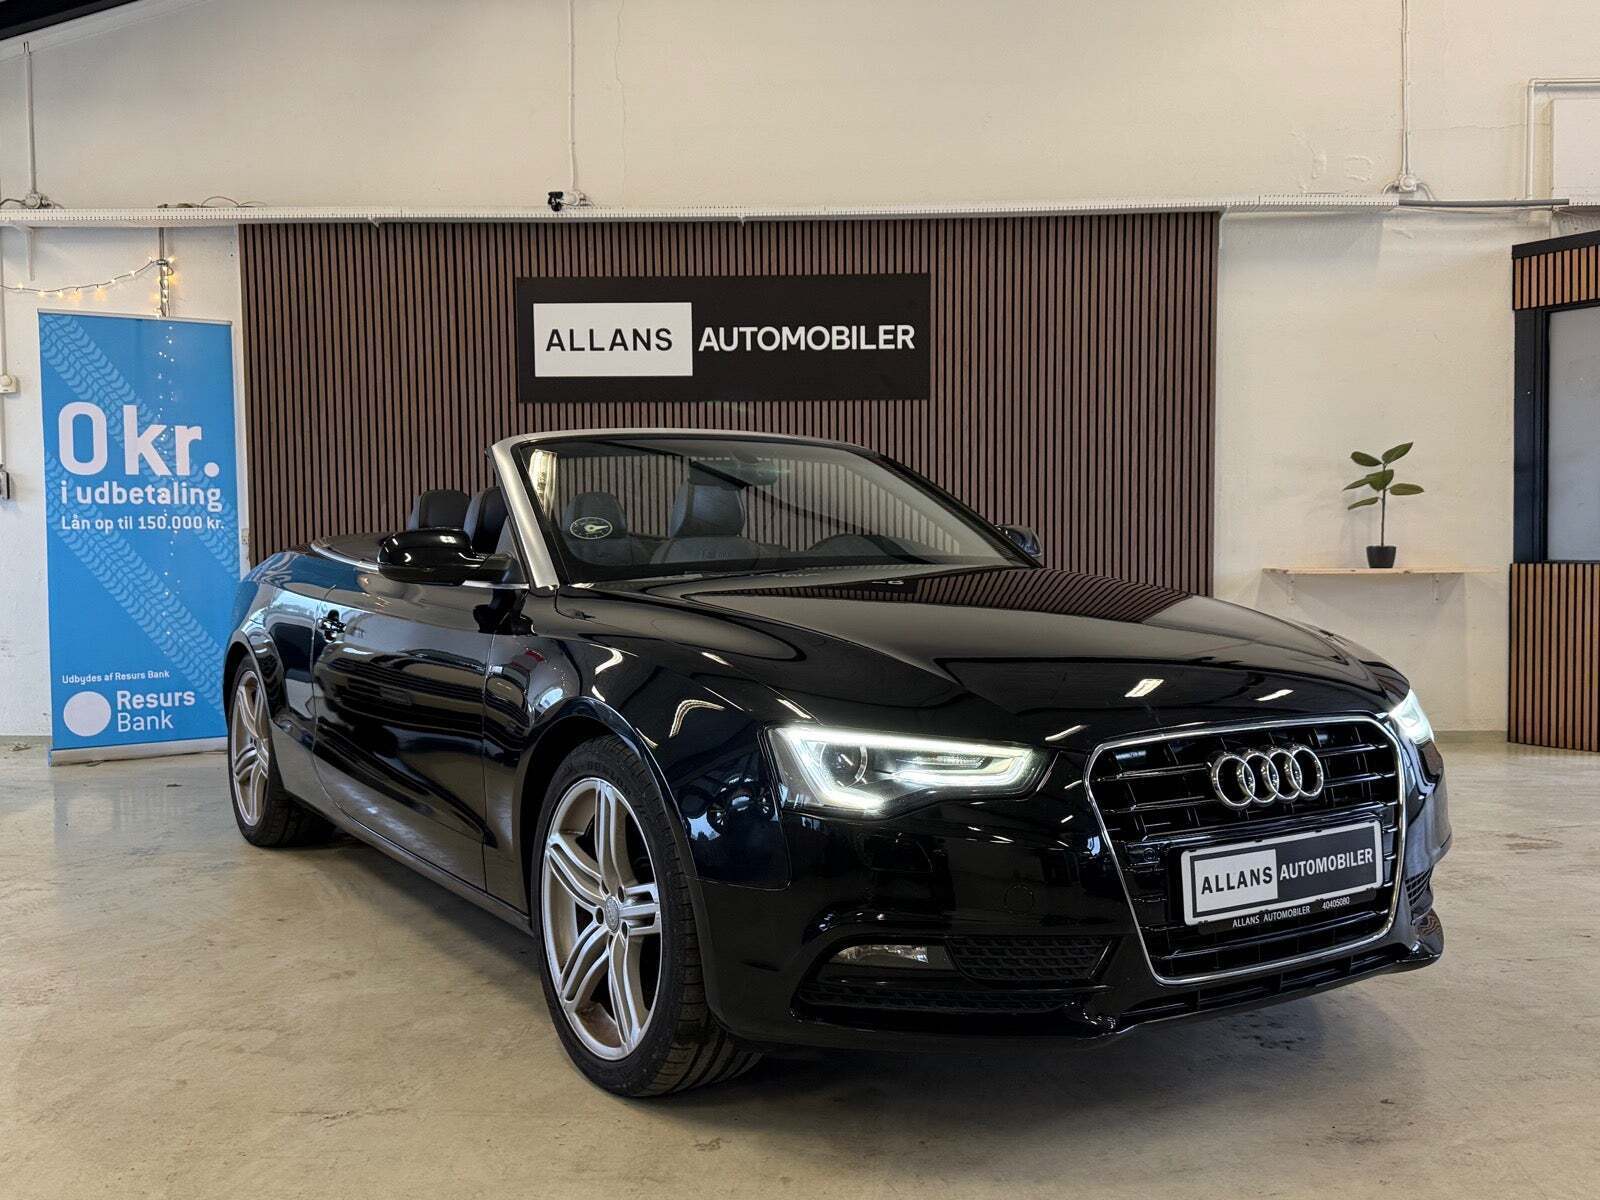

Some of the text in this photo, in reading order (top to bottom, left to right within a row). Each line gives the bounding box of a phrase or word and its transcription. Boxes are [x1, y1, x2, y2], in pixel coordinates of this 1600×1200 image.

[546, 324, 915, 352] ALLANS AUTOMOBILER
[58, 401, 220, 477] 0 kr.
[60, 480, 223, 512] i udbetaling
[61, 514, 225, 534] Lån op til 150.000 kr.
[62, 670, 170, 685] Udbydes af Resurs Bank
[116, 690, 196, 711] Resurs
[117, 710, 174, 733] Bank
[1201, 848, 1373, 895] ALLANS AUTOMOBILER
[1232, 915, 1260, 928] ALLANS
[1263, 905, 1311, 922] AUTOMOBILER
